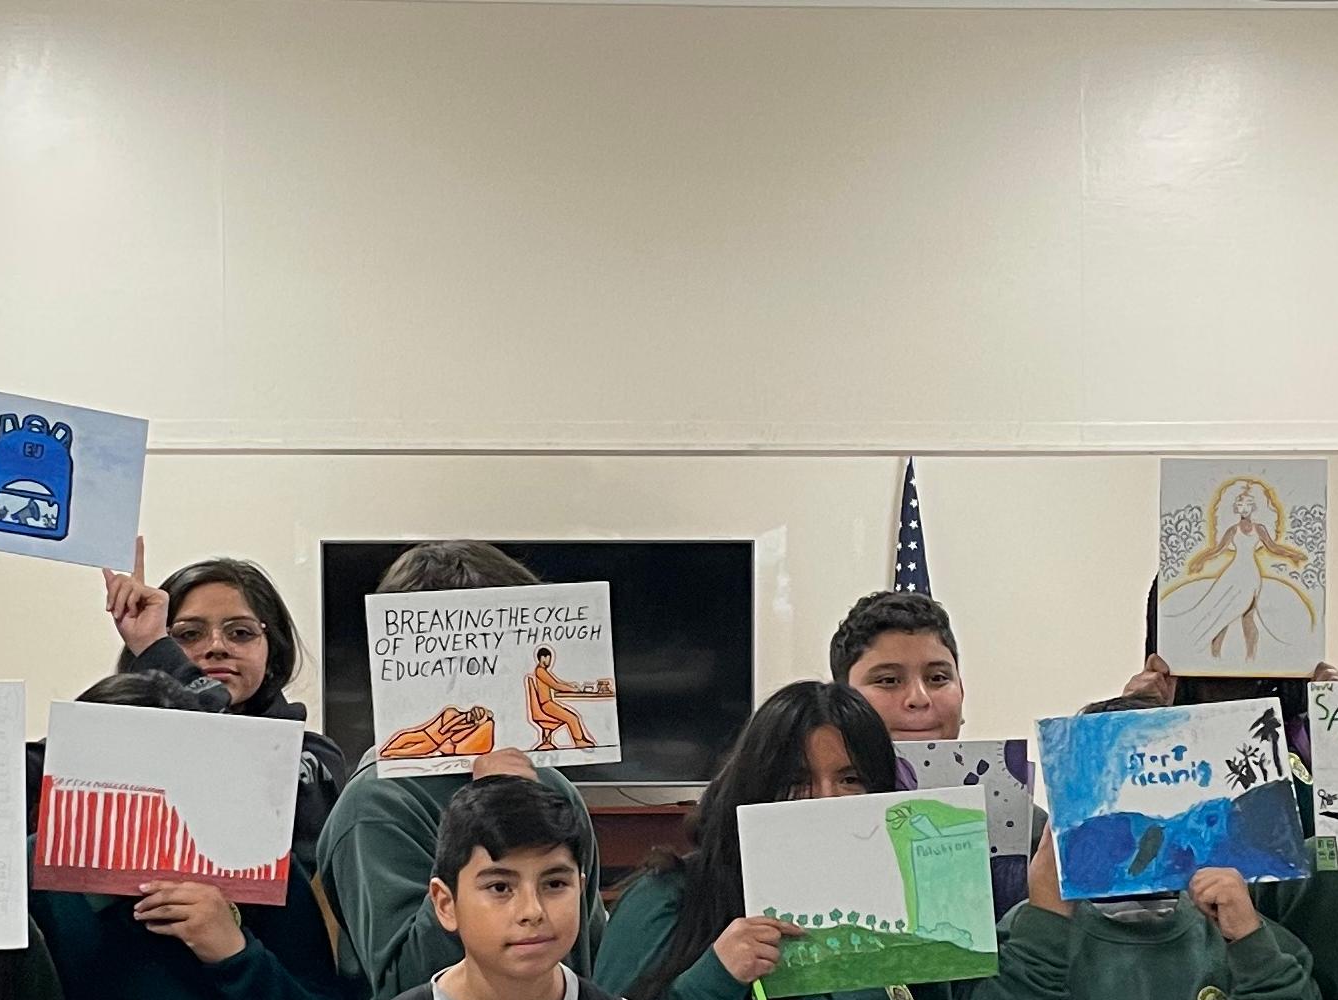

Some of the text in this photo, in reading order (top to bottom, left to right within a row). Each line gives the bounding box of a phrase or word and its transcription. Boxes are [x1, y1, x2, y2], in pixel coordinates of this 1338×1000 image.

[385, 605, 589, 636] BREAKING THE CYCLE
[375, 624, 602, 656] OF POVERTY THROUGH
[381, 654, 499, 682] EDUCATION
